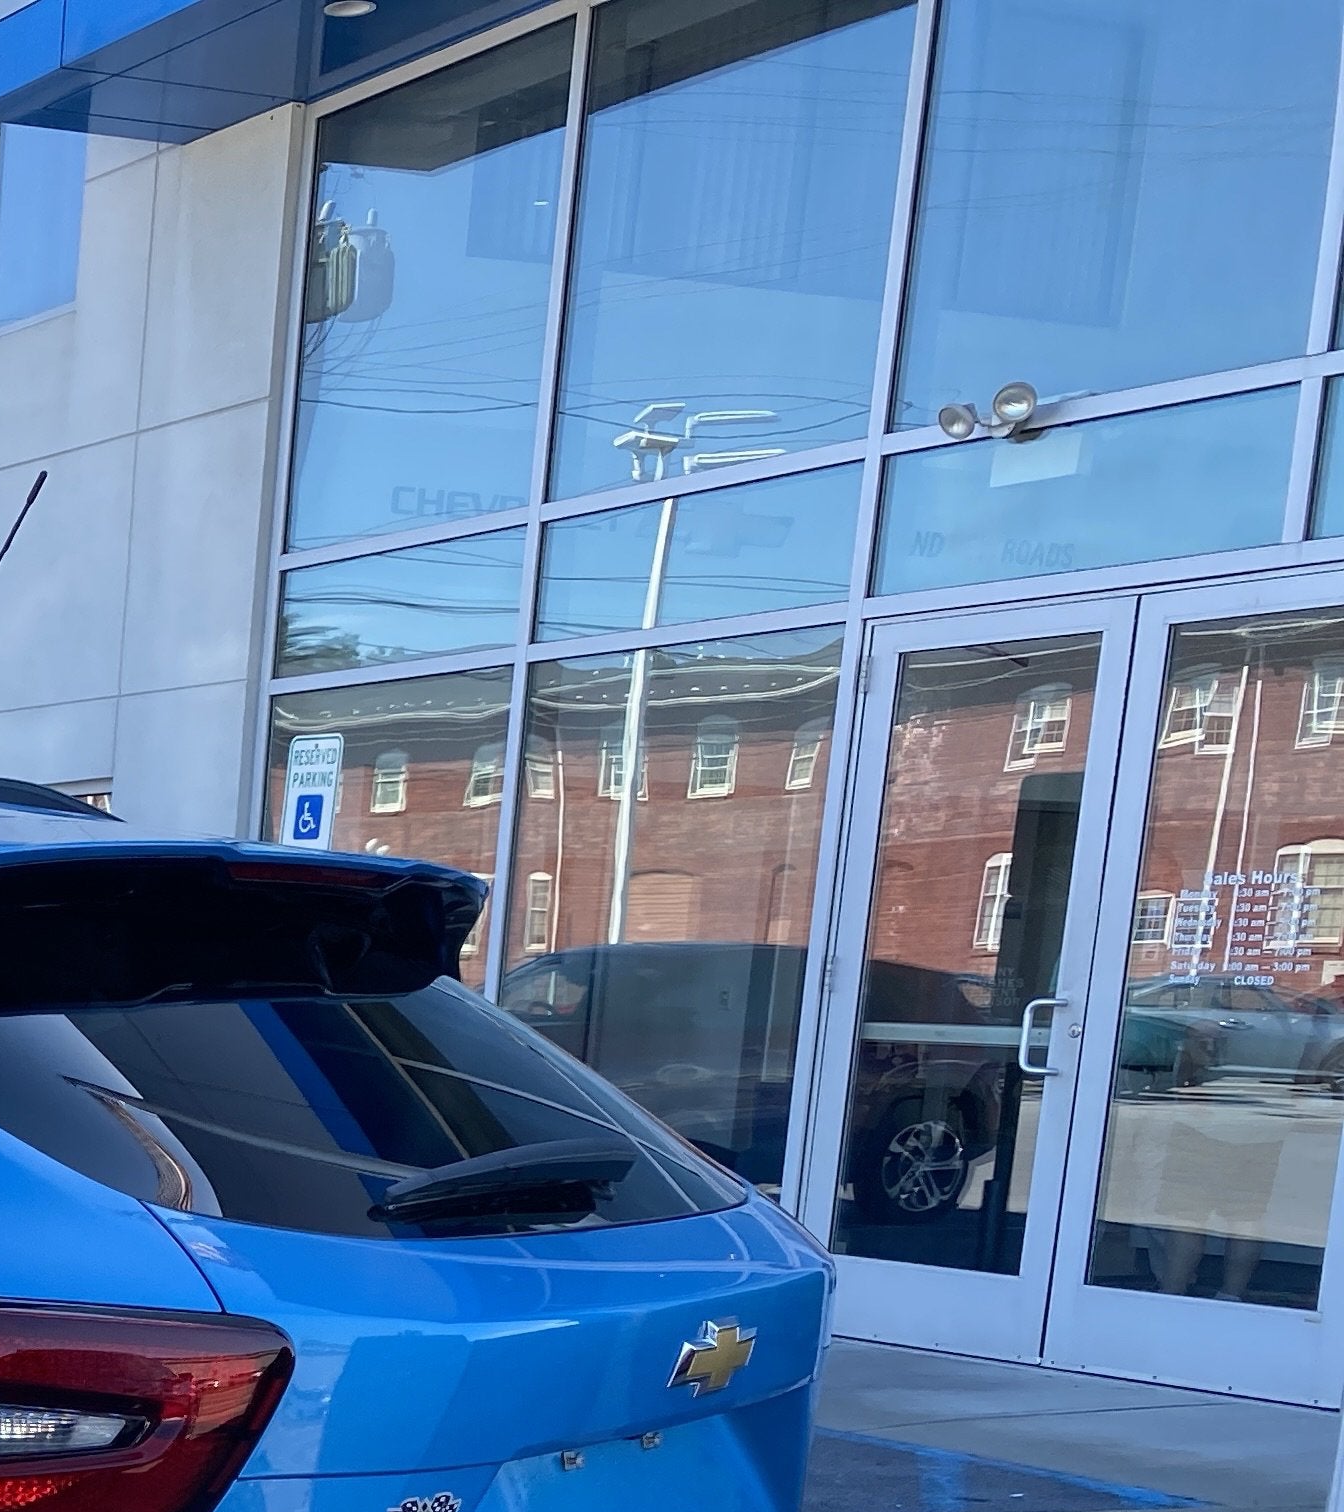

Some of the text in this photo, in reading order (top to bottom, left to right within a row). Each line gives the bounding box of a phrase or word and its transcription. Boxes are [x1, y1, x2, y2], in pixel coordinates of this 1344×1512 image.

[1001, 538, 1075, 568] ROADS
[294, 747, 338, 766] RESERVED
[292, 771, 334, 788] PARKING
[1255, 889, 1270, 897] am
[1253, 904, 1268, 912] am
[1251, 919, 1265, 927] am
[1297, 948, 1312, 957] pm
[1170, 961, 1216, 973] Saturday
[1223, 961, 1243, 971] :00
[1244, 963, 1259, 971] am
[1272, 962, 1293, 971] 3:00
[1295, 963, 1310, 973] pm
[1169, 974, 1275, 986] Sunday CLOSED
